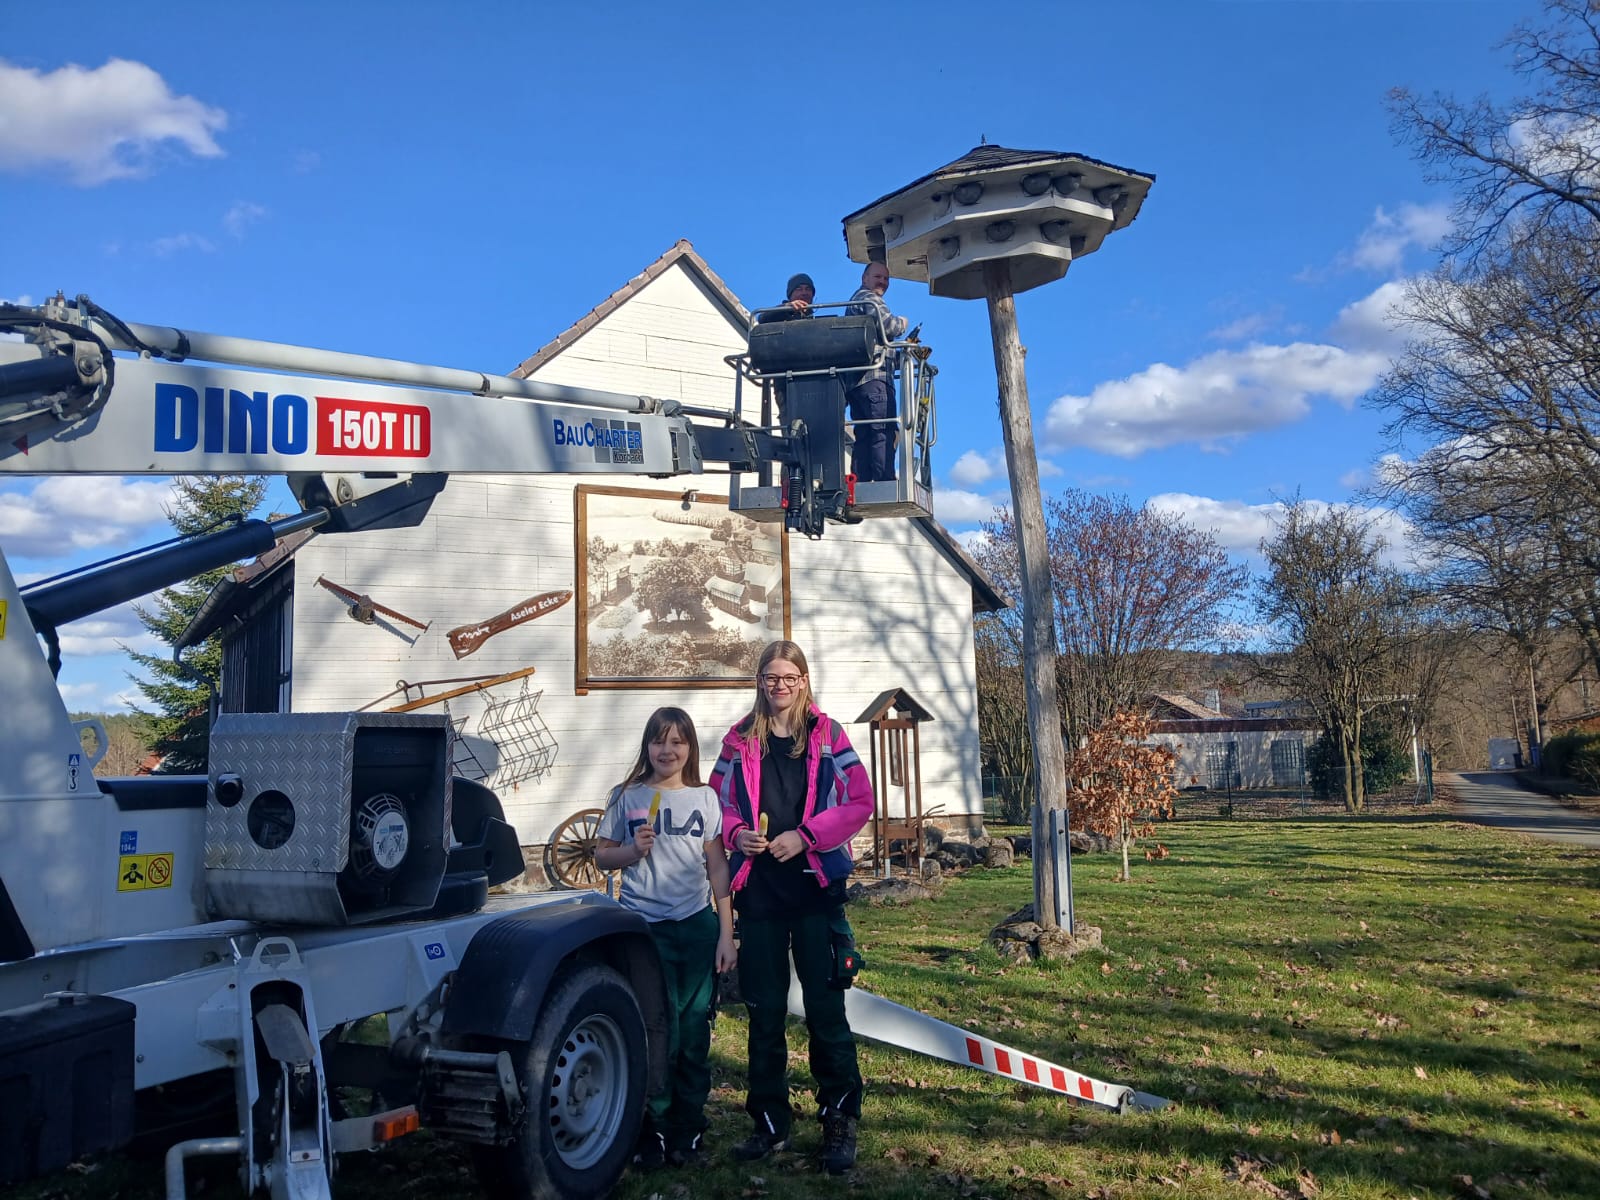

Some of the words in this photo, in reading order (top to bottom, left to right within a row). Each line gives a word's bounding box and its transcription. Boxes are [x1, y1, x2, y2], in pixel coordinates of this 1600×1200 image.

[154, 383, 308, 455] DINO
[328, 409, 397, 449] 150T
[510, 606, 537, 622] Aseler
[538, 596, 559, 610] Ecke
